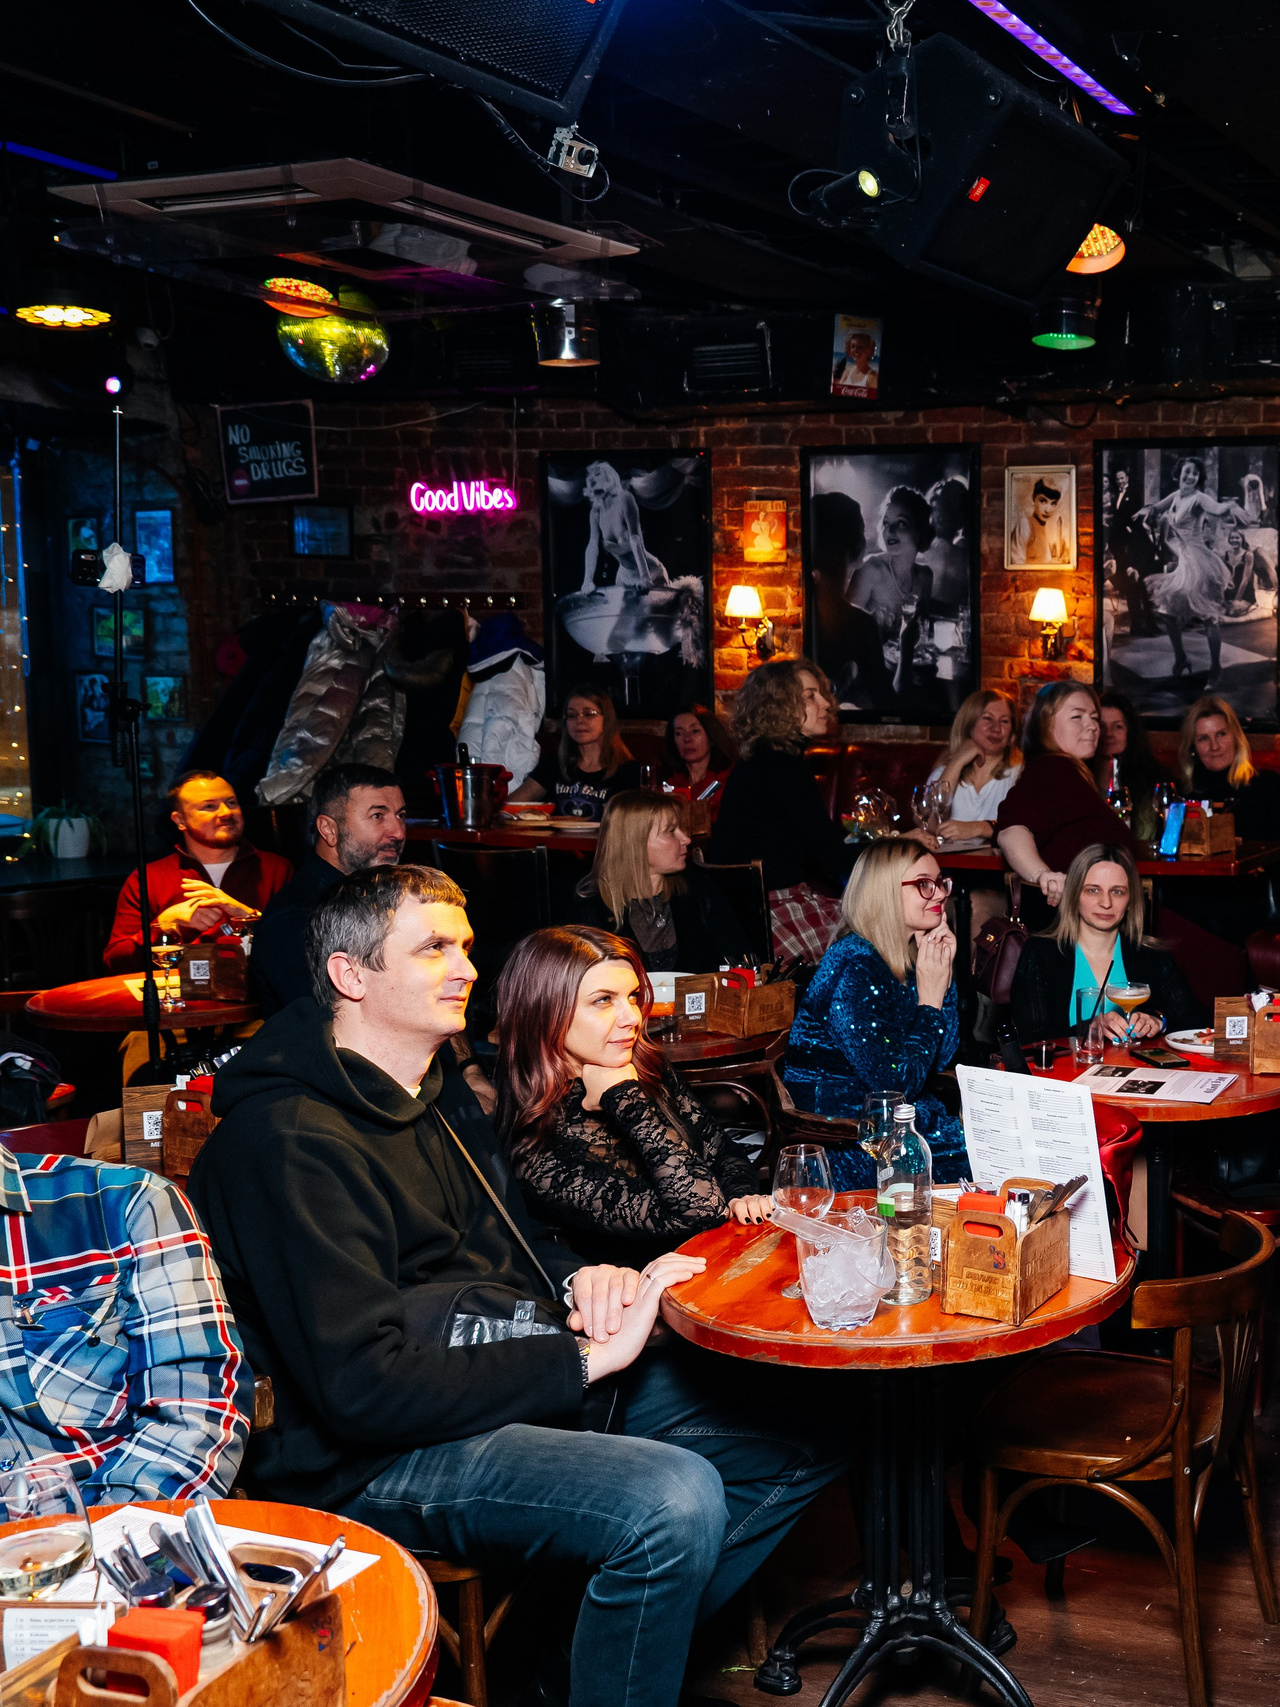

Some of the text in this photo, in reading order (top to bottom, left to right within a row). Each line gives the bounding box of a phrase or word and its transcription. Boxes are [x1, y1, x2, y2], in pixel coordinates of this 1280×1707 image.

[228, 424, 251, 445] NO
[250, 457, 307, 481] DRUGS
[410, 480, 514, 512] Good Vibes
